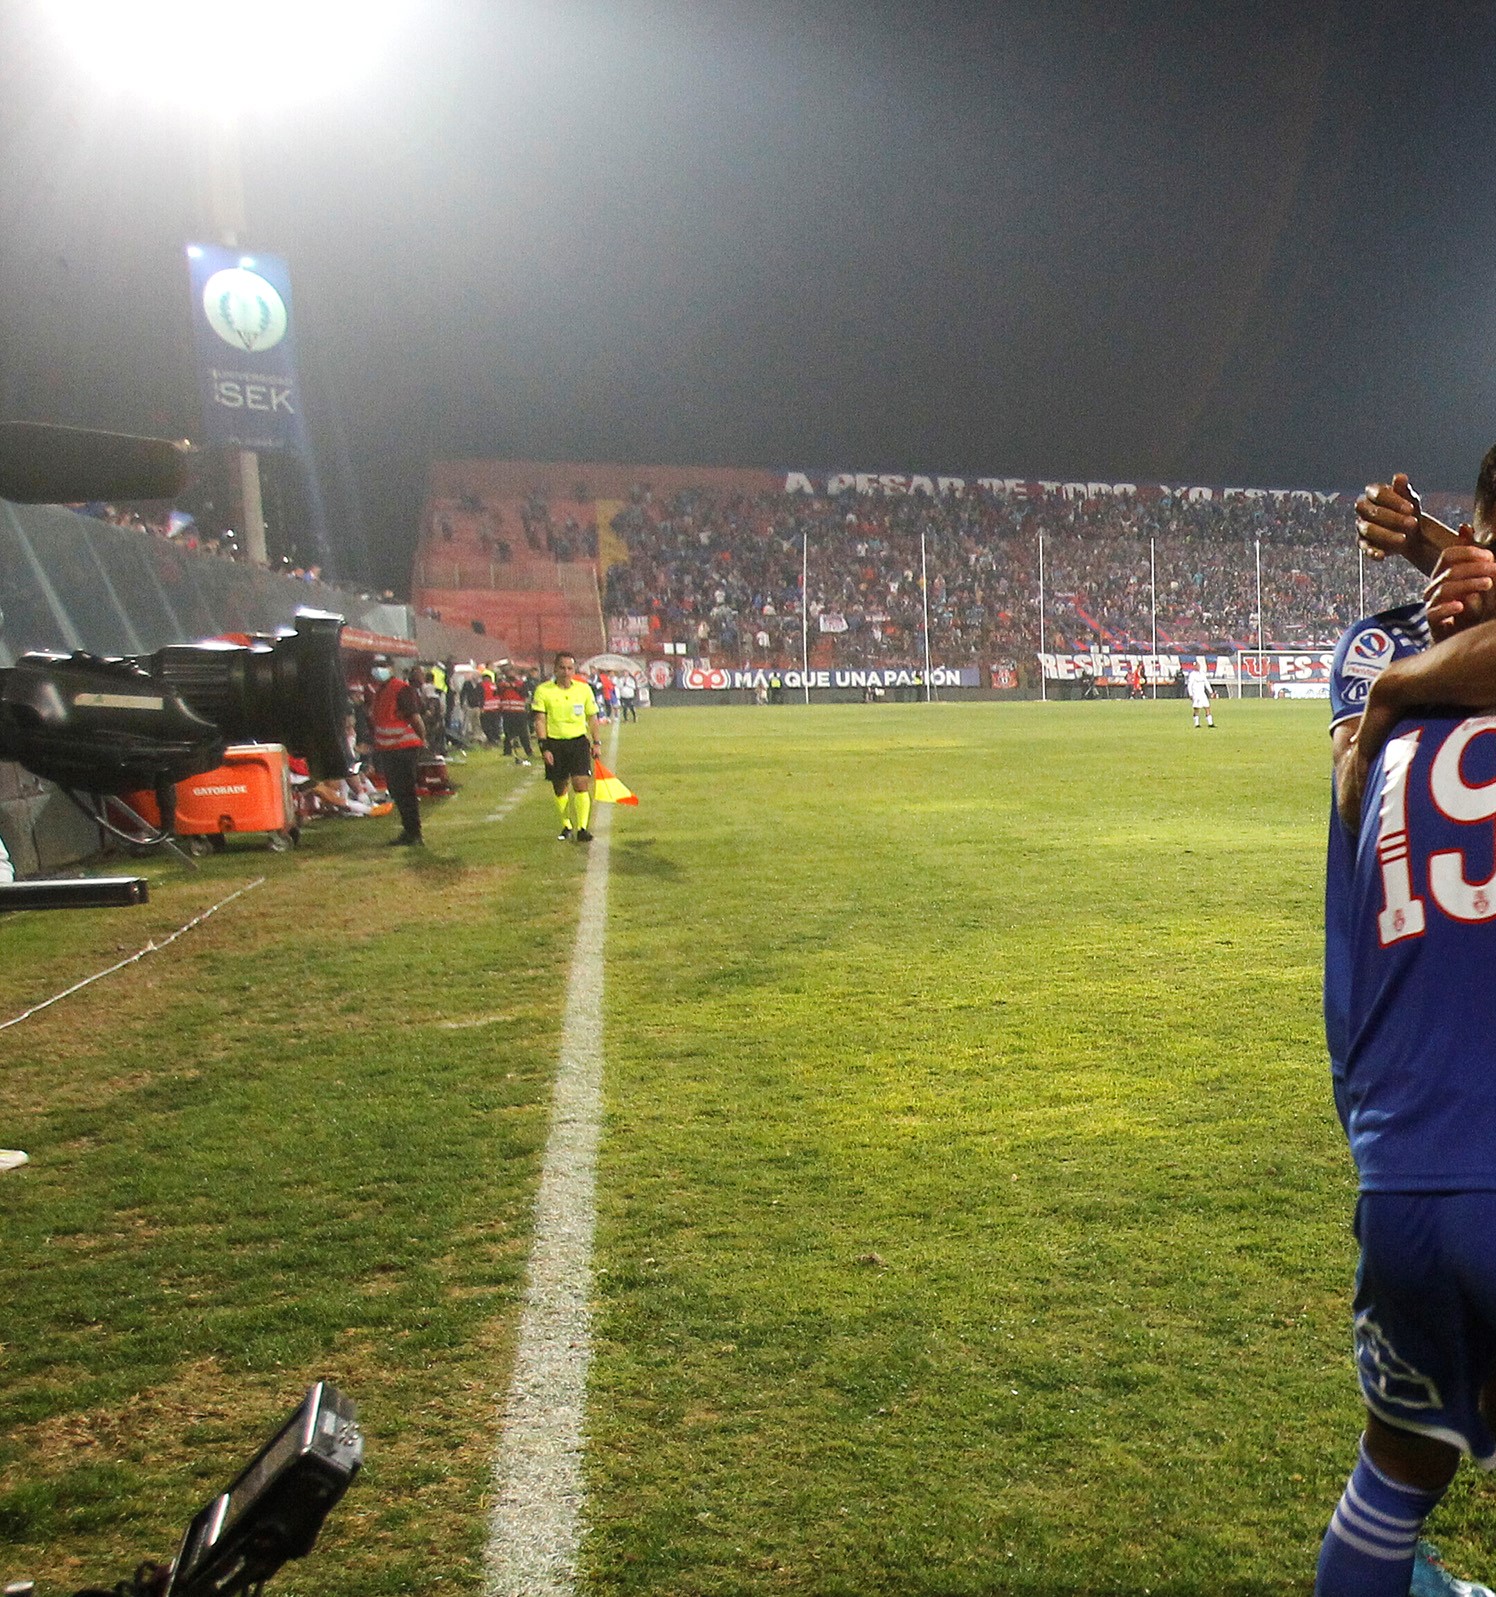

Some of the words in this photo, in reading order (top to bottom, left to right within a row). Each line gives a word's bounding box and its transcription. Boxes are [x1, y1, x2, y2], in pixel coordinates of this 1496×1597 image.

[219, 381, 295, 414] SEK
[785, 472, 813, 494] A
[1037, 652, 1181, 680] RESPETEN
[1244, 656, 1271, 679] U
[1278, 655, 1313, 680] ES
[784, 670, 831, 688] QUE
[835, 671, 884, 688] UNA
[193, 784, 248, 797] GATORADE
